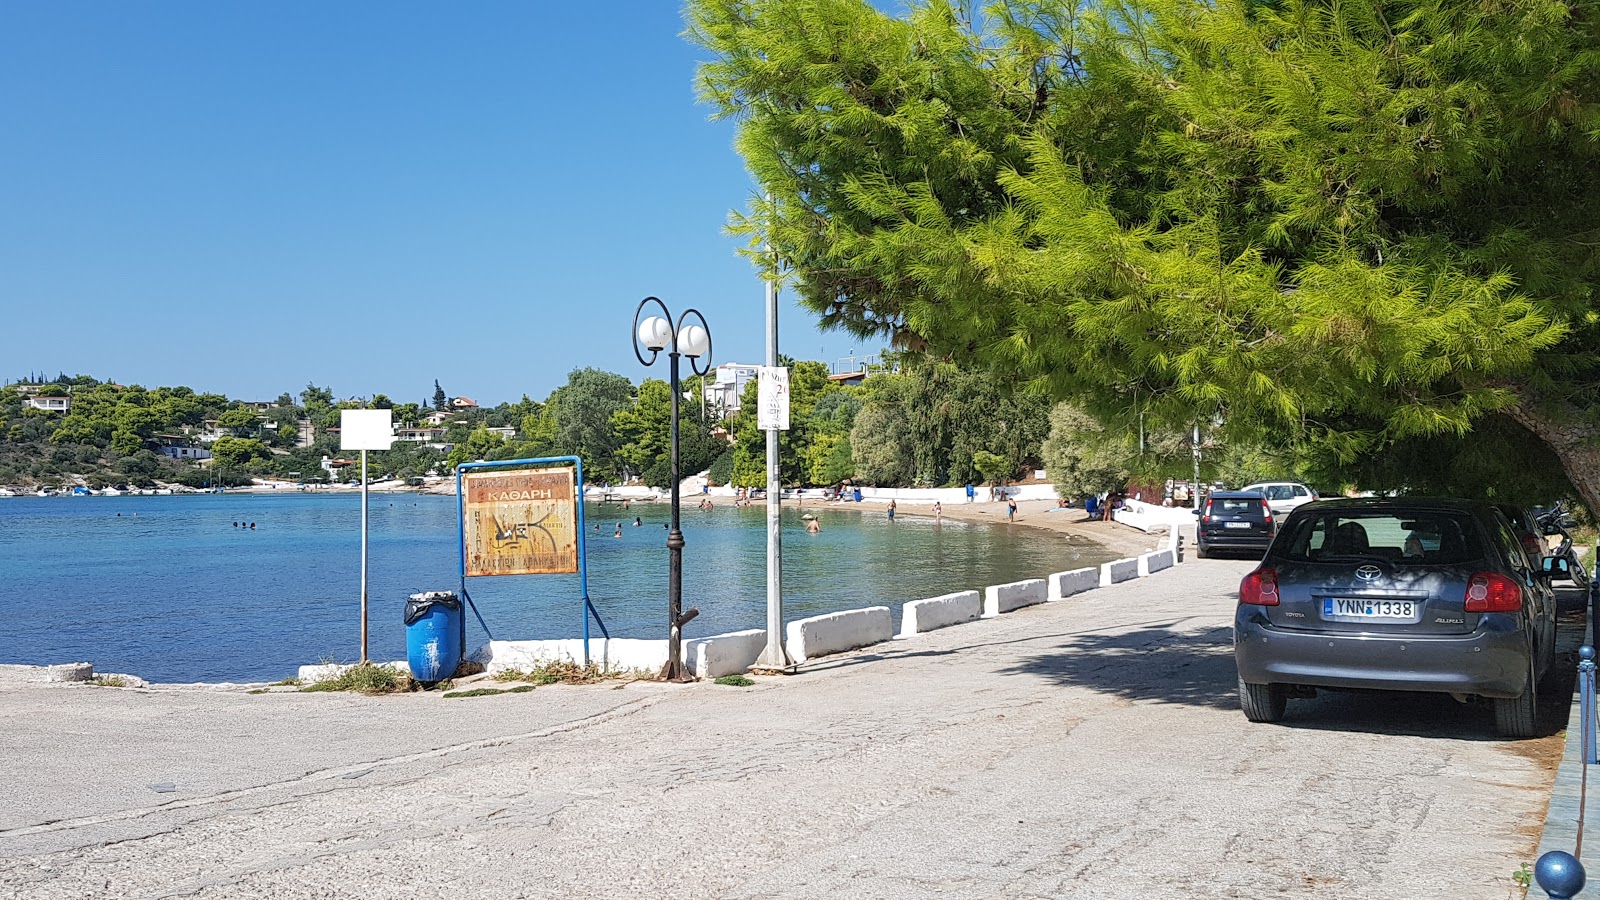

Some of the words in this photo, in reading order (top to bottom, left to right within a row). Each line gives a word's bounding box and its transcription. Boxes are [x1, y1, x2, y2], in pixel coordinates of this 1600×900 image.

[488, 489, 552, 501] ΚΑΘΑΡΗ
[1337, 599, 1365, 614] YNN
[1374, 601, 1412, 616] 1338
